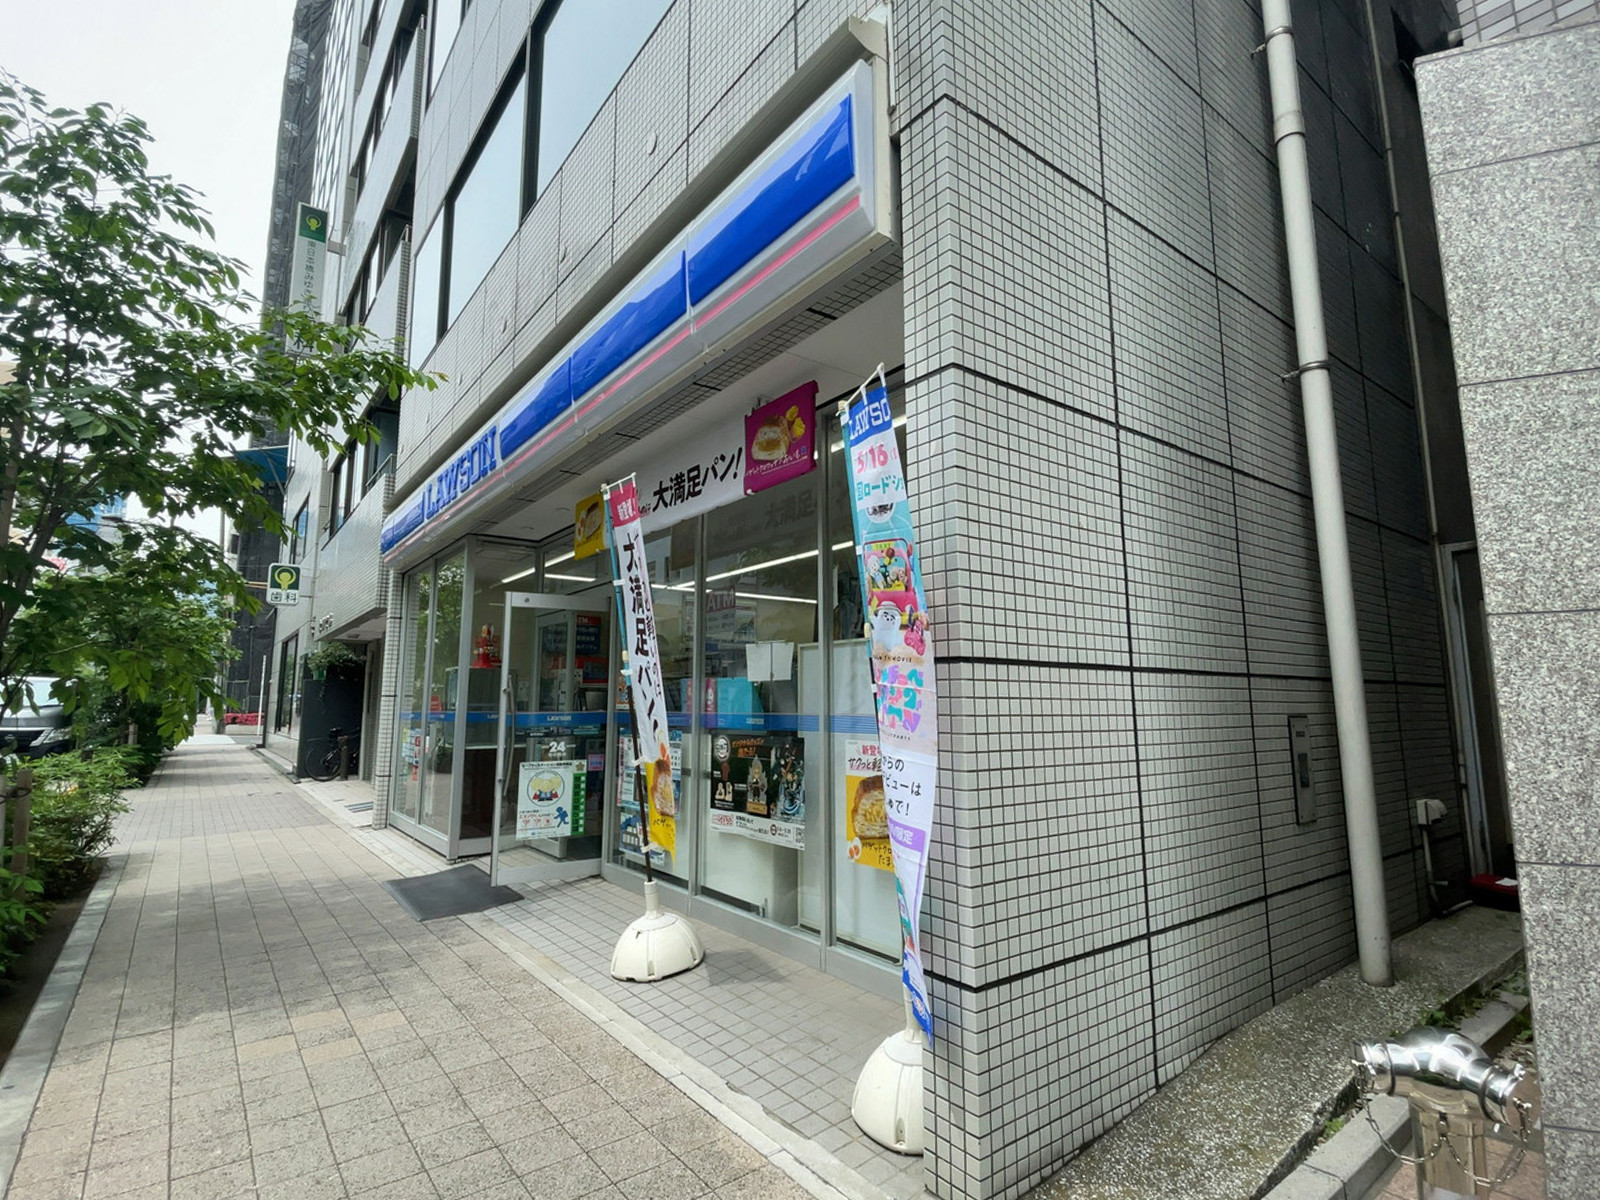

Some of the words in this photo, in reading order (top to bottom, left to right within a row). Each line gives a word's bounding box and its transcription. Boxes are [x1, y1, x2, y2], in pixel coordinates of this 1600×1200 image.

[425, 425, 498, 520] LAWSON
[652, 447, 743, 513] 大満足パン!
[548, 741, 567, 753] 24
[884, 772, 922, 797] ビューは
